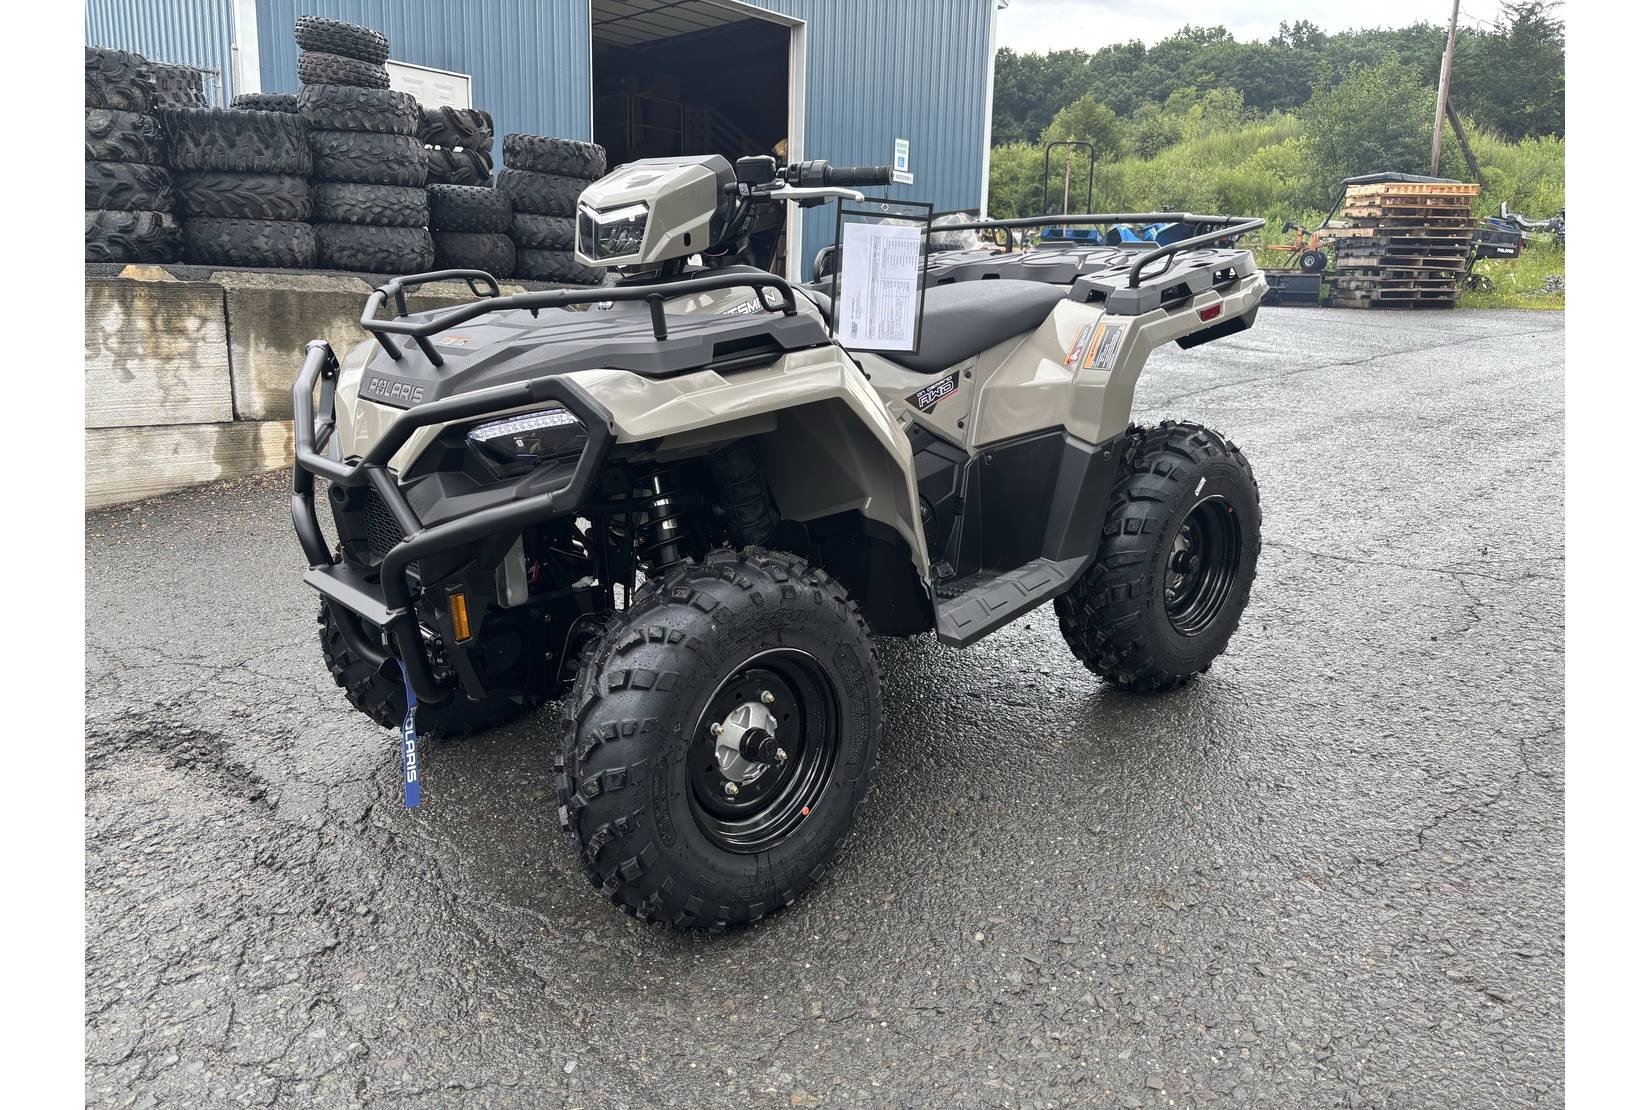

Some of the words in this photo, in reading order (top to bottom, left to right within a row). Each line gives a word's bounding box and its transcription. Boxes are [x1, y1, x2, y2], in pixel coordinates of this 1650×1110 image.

[368, 377, 425, 403] POLARIS
[918, 381, 954, 407] AWD
[404, 706, 417, 783] POLARIS
